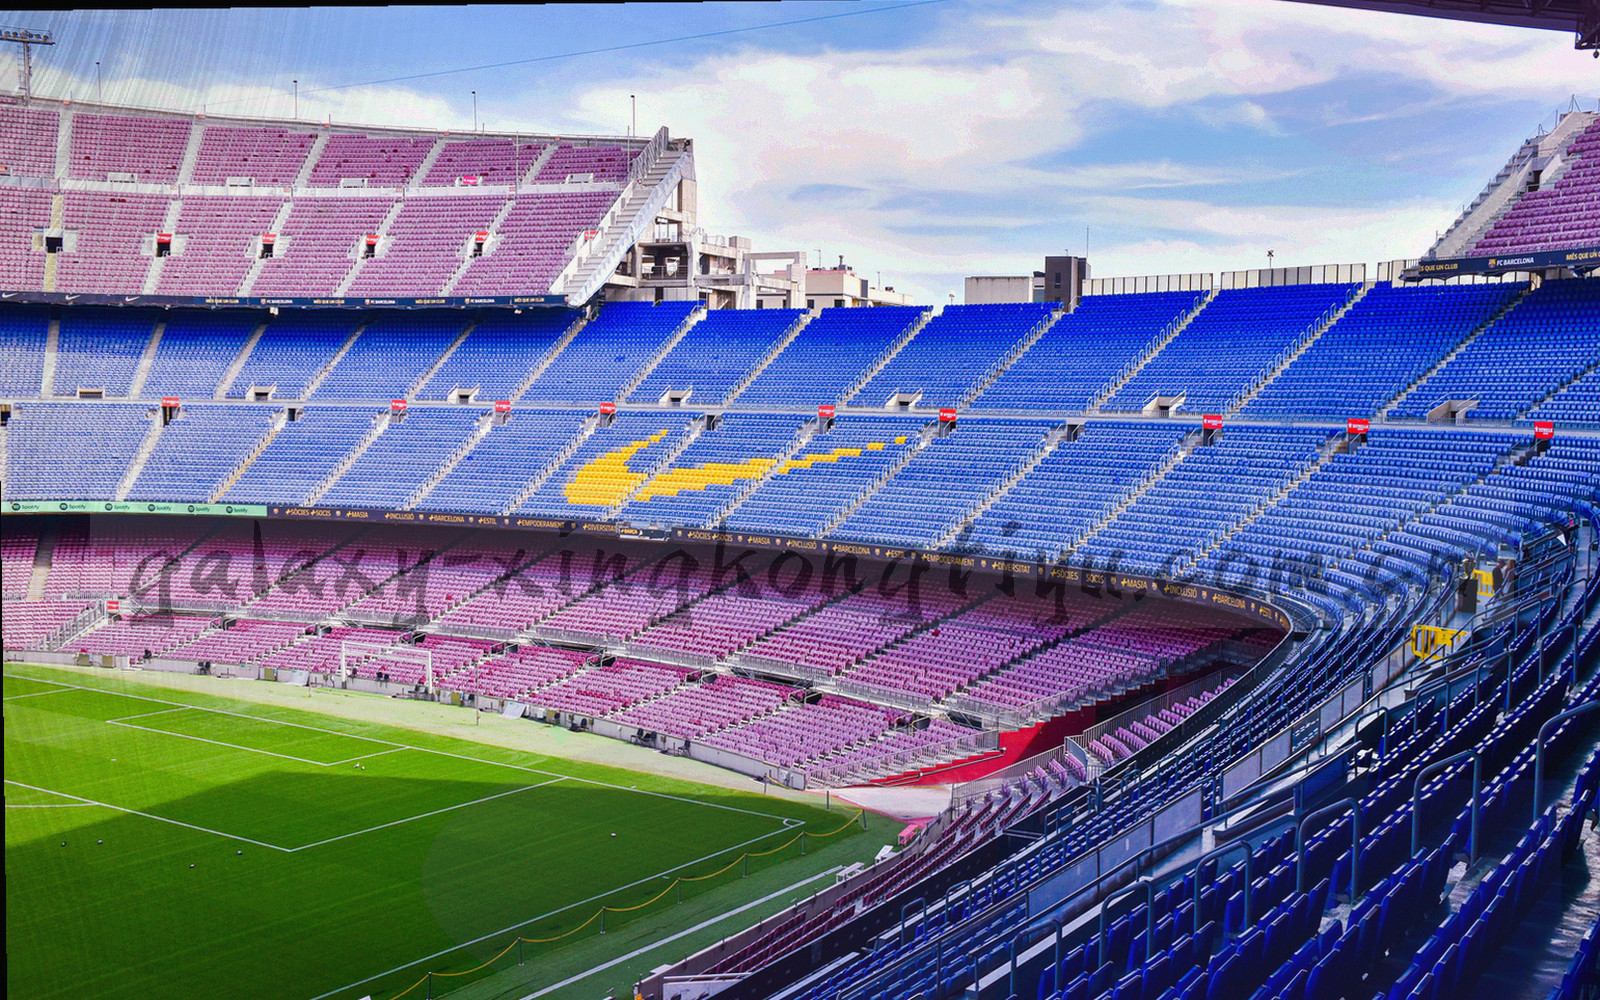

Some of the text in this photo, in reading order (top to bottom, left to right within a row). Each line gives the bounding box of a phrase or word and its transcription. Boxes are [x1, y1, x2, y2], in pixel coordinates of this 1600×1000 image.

[1566, 252, 1577, 260] MÉS
[1578, 252, 1588, 260] QUE
[1504, 257, 1534, 265] BARCELONA
